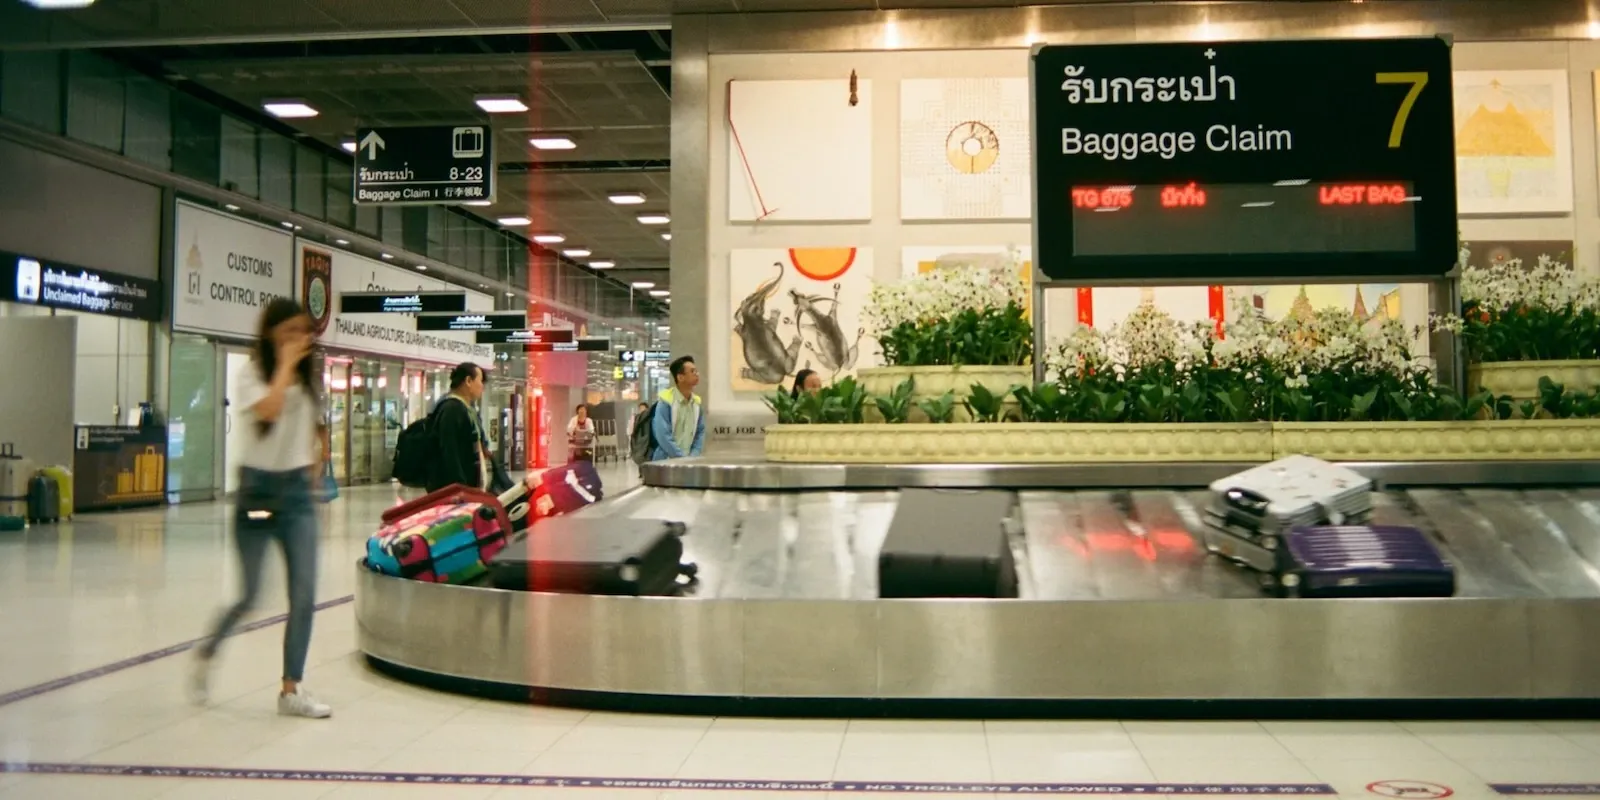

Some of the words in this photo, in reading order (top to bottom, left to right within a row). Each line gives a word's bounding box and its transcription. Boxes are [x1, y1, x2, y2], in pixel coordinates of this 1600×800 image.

[1061, 47, 1236, 104] รับกระเป๋า
[1375, 71, 1429, 149] 7
[1061, 127, 1196, 161] Baggage
[1205, 124, 1292, 152] Claim
[359, 162, 414, 181] รับกระเป๋า
[449, 167, 483, 180] 8-23
[358, 189, 401, 201] Baggage
[403, 188, 430, 198] Claim
[1072, 188, 1099, 208] TG
[1319, 185, 1365, 205] LAST
[1367, 184, 1406, 205] BAG
[227, 252, 273, 278] CUSTOMS
[43, 287, 81, 304] Unclaimed
[82, 292, 110, 310] Baggage
[111, 297, 134, 312] Service
[210, 282, 257, 306] CONTROL
[335, 318, 365, 337] THAILAND
[366, 323, 405, 343] AGRICULTURE
[713, 426, 731, 435] ART
[736, 426, 756, 434] FOR
